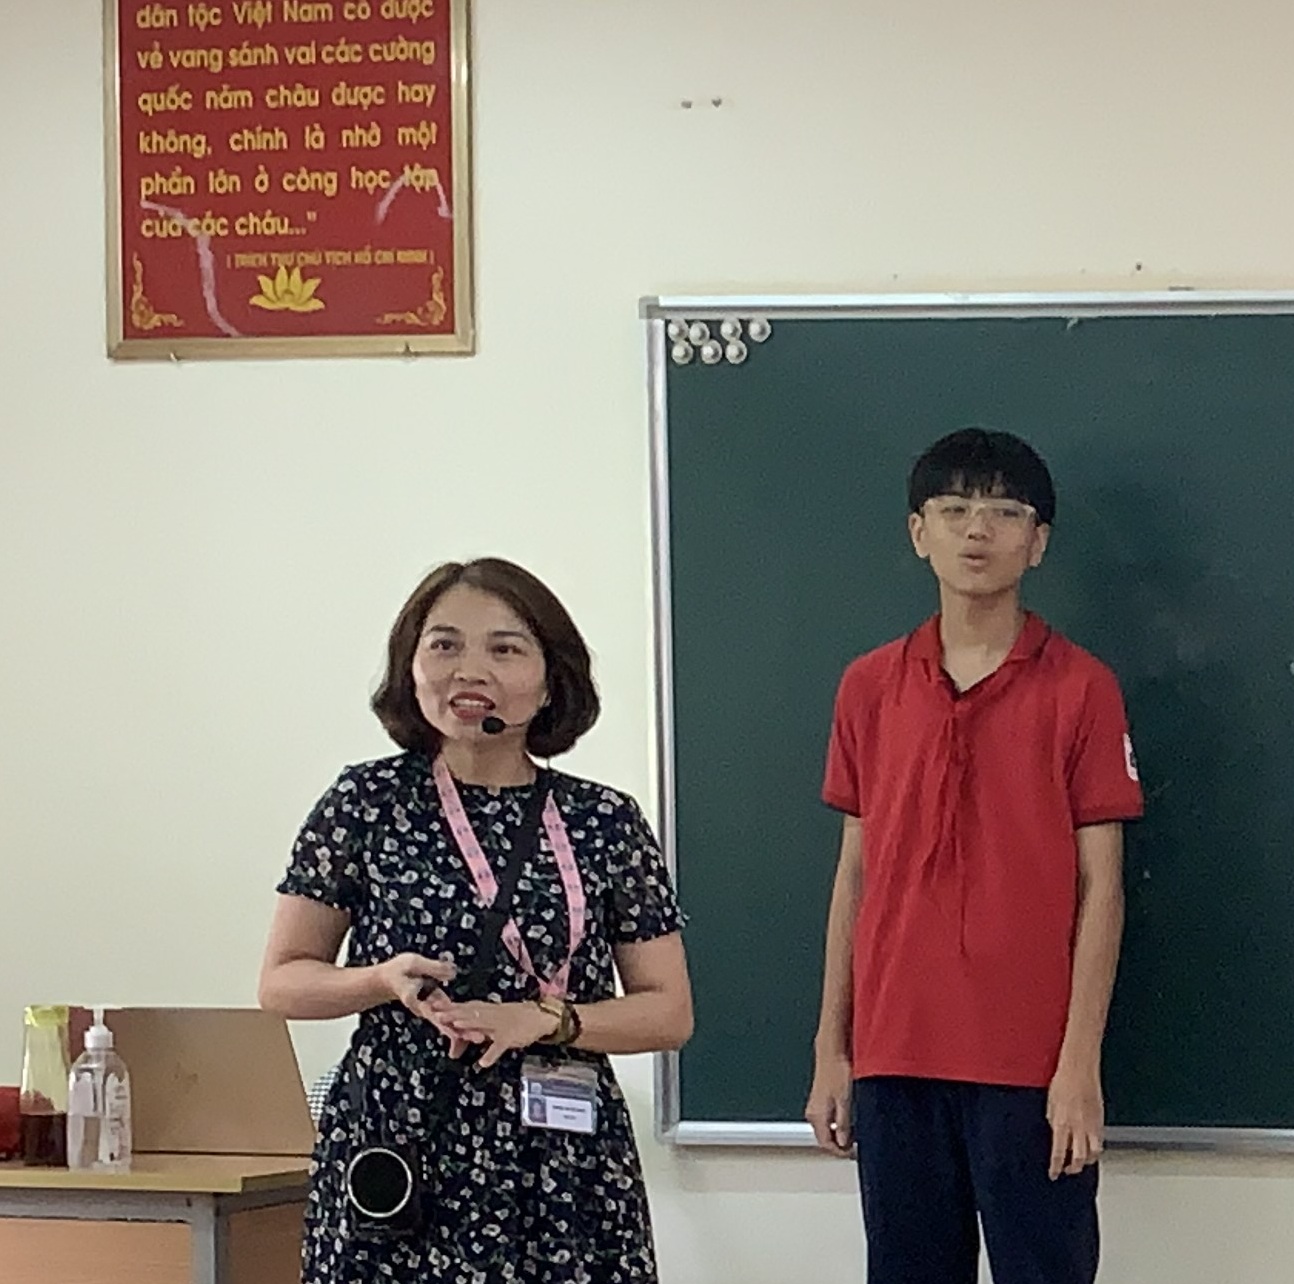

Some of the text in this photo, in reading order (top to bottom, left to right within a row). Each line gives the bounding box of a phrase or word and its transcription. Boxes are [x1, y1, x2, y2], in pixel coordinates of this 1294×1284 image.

[284, 0, 332, 22] Nam
[169, 49, 222, 72] vang
[229, 42, 278, 66] sánh
[322, 38, 362, 63] các
[398, 81, 435, 107] hay
